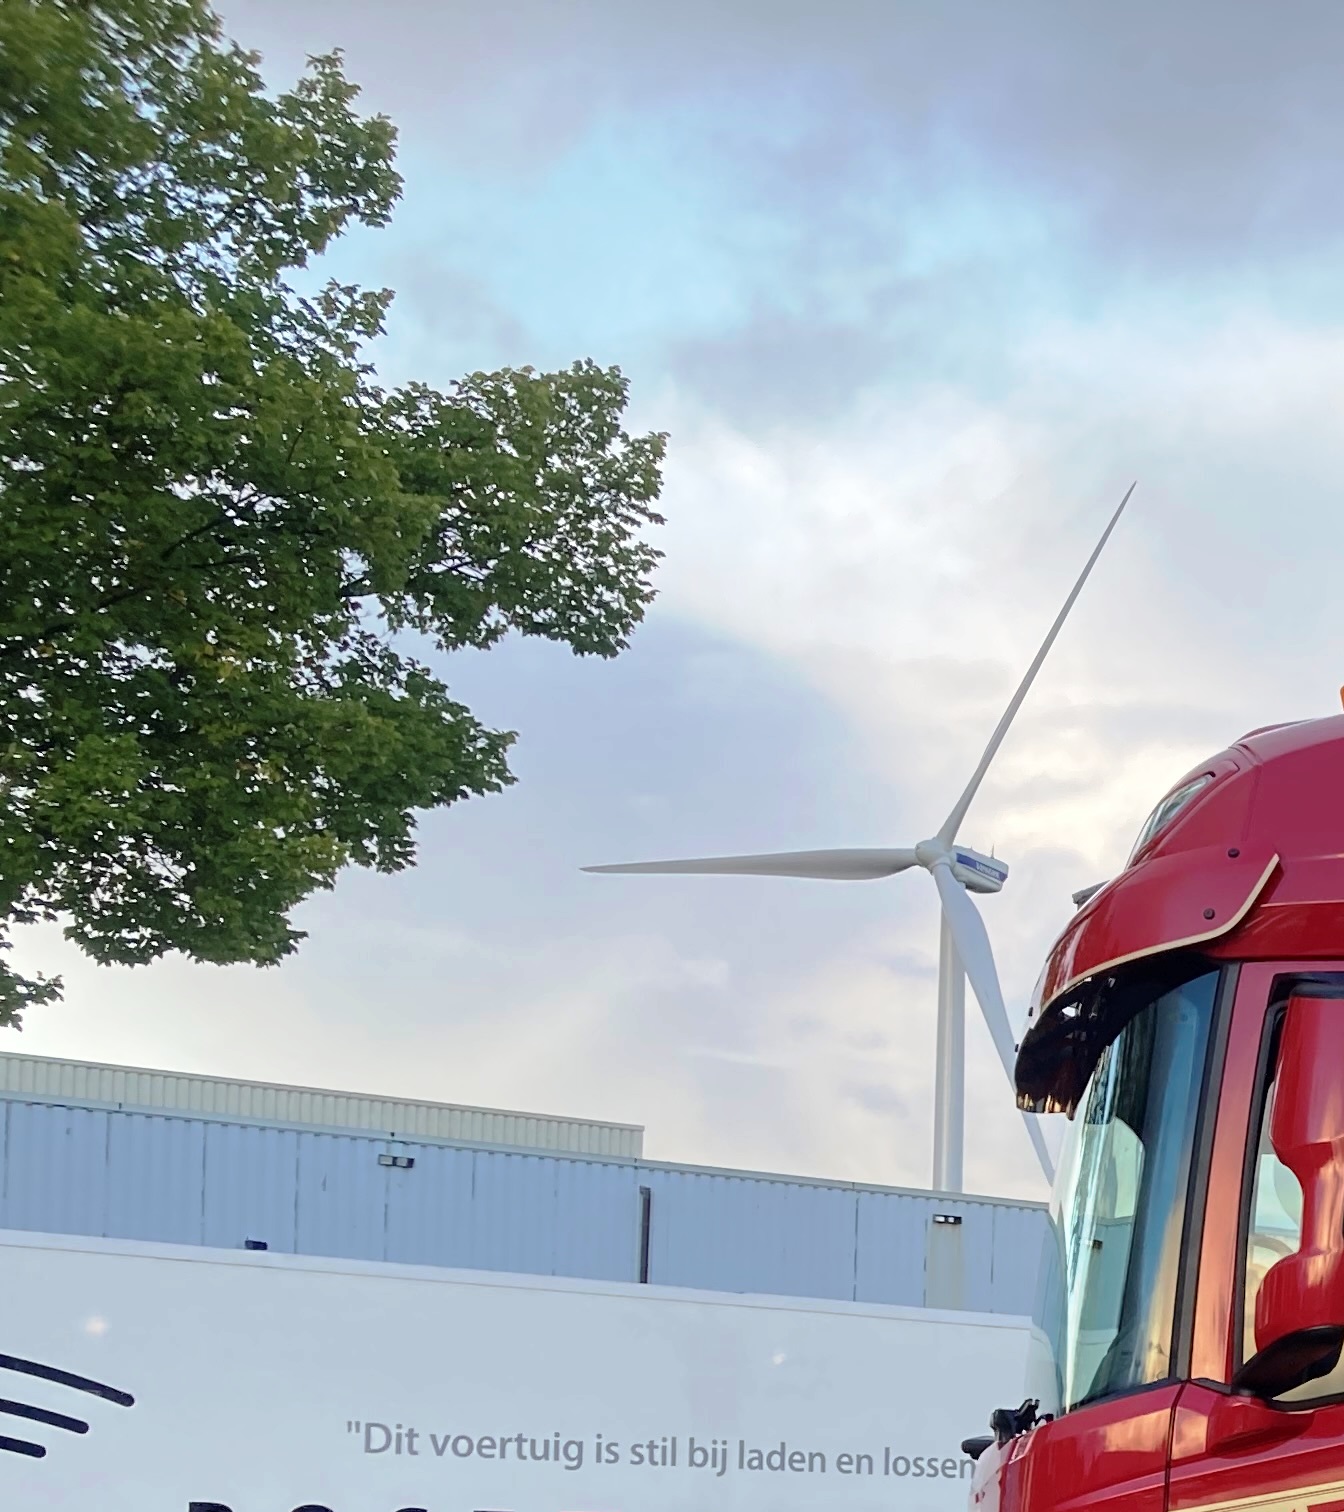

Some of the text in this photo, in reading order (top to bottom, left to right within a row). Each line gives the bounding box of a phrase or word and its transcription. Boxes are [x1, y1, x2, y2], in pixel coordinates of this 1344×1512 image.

[347, 1421, 420, 1456] "Dit
[429, 1431, 584, 1471] voertuig
[595, 1433, 620, 1464] is
[630, 1436, 677, 1467] stil
[688, 1437, 728, 1477] bij
[738, 1440, 826, 1473] laden
[836, 1452, 874, 1475] en
